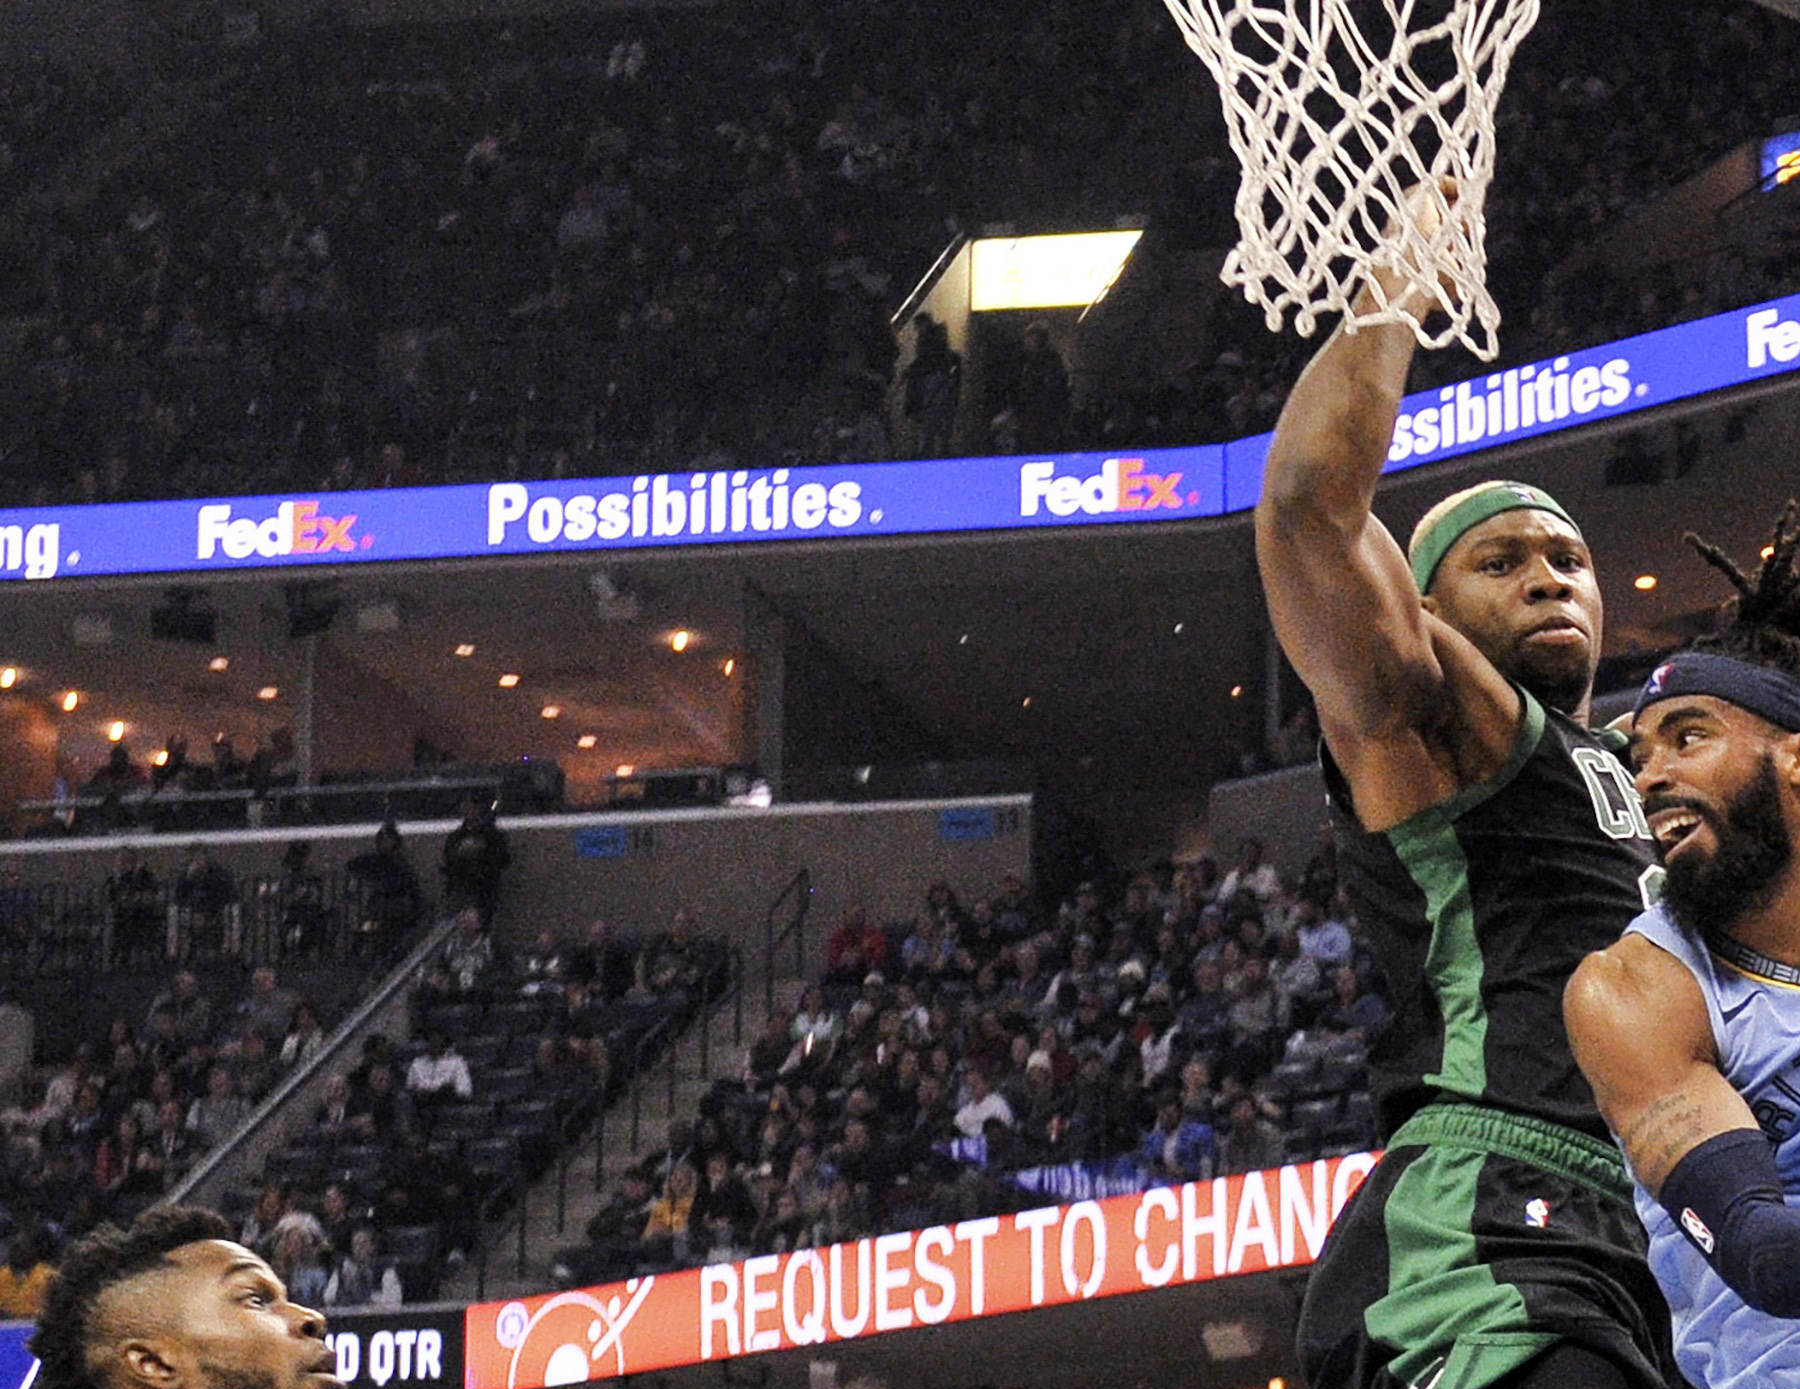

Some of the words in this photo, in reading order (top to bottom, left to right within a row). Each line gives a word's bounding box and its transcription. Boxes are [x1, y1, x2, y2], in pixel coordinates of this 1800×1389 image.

[700, 1216, 999, 1360] REQUEST
[1014, 1200, 1107, 1306] TO
[325, 1332, 360, 1382] D
[369, 1329, 442, 1386] QTR
